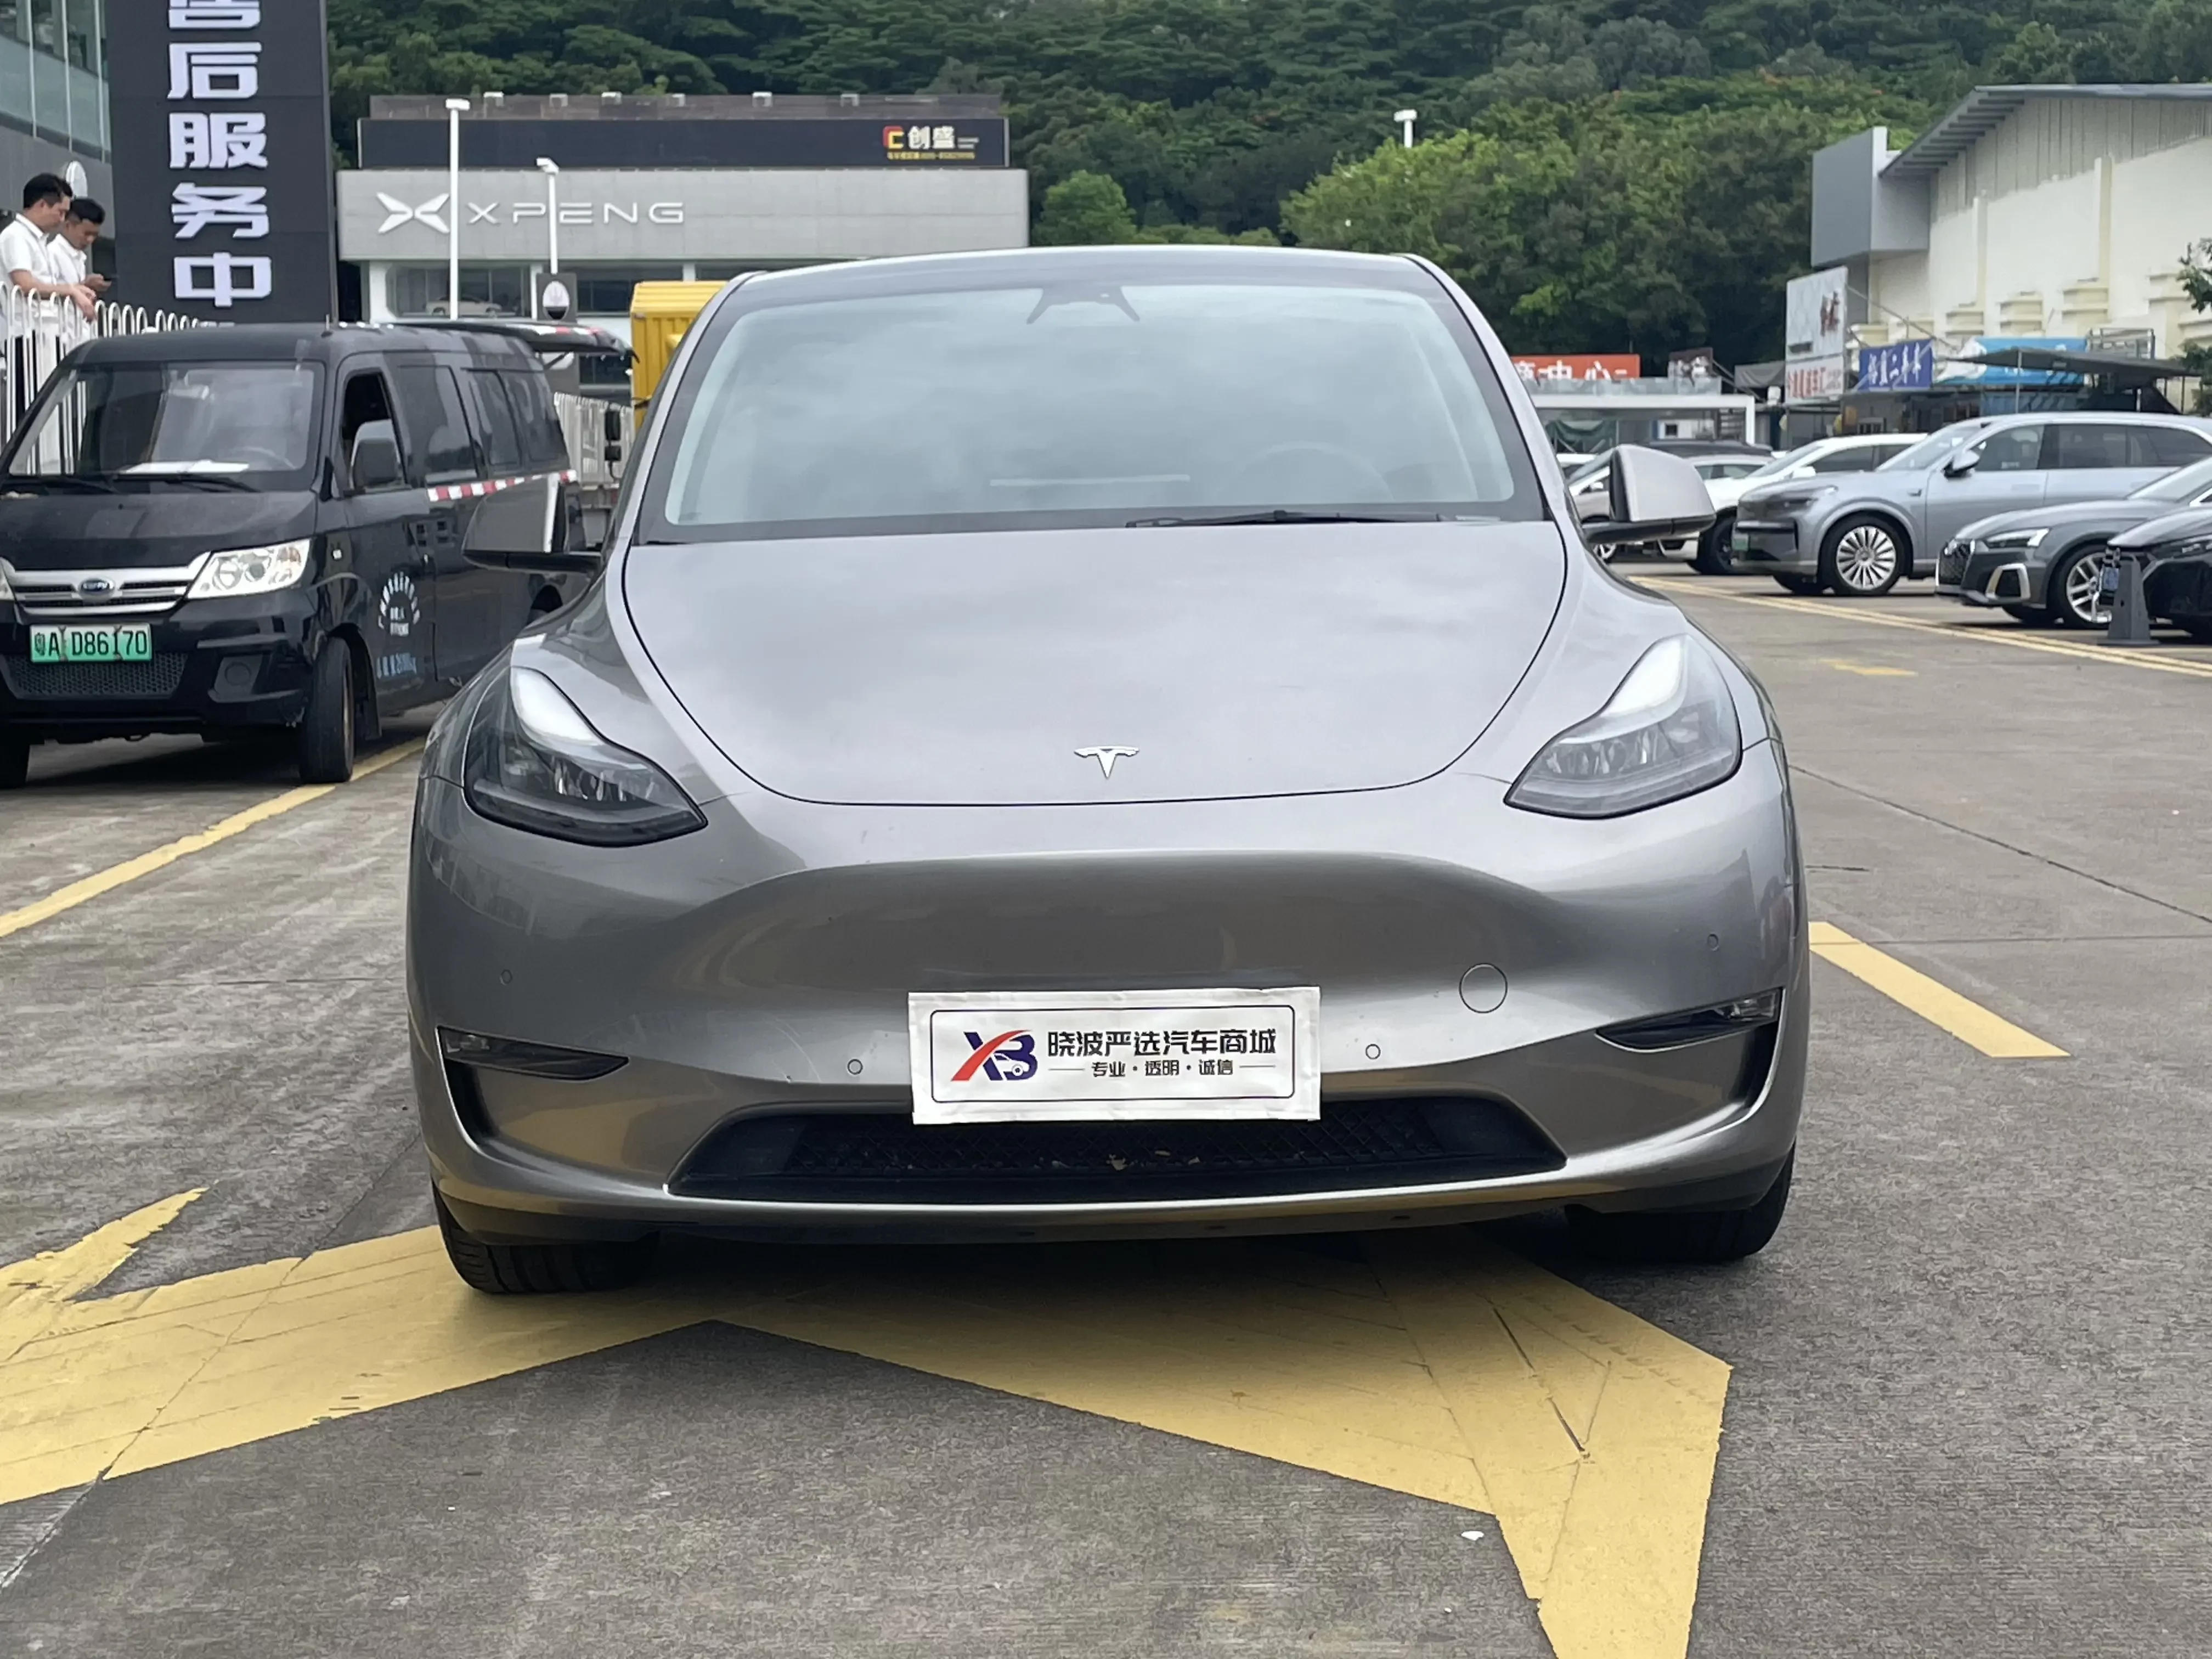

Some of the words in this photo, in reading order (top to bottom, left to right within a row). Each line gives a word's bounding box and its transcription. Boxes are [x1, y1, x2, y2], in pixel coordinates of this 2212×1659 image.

[908, 126, 955, 149] 创盛
[467, 201, 684, 225] XPENG
[1047, 1028, 1277, 1057] 晓波严选汽车商城
